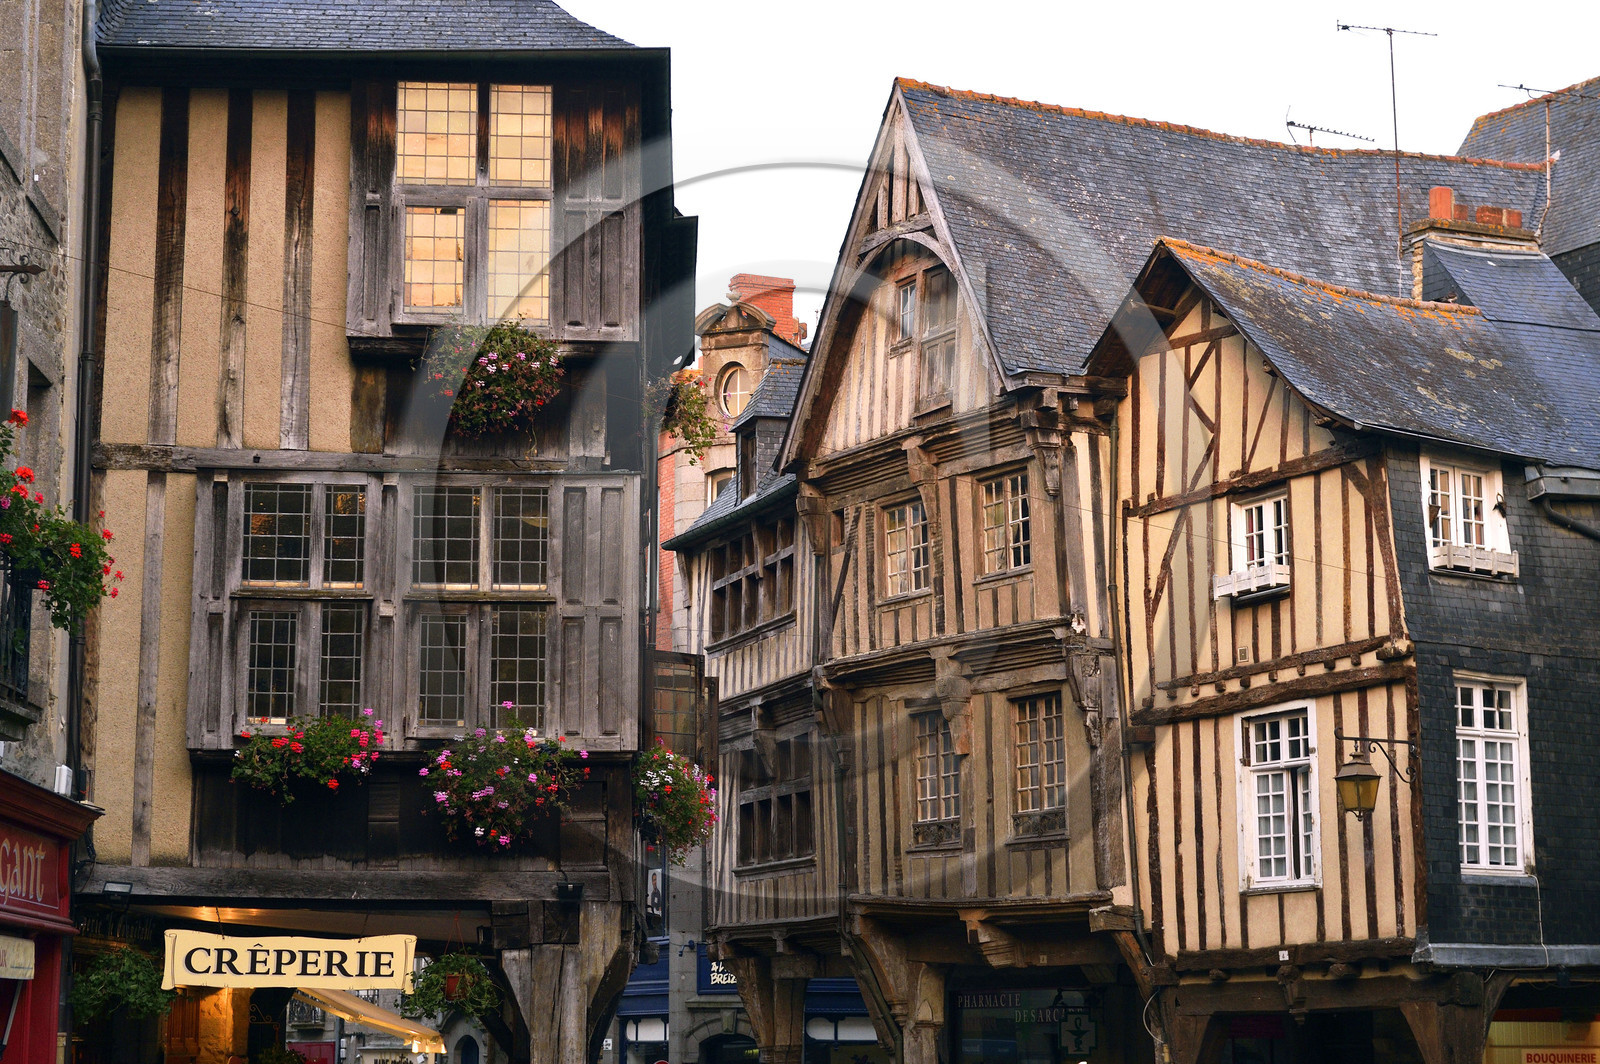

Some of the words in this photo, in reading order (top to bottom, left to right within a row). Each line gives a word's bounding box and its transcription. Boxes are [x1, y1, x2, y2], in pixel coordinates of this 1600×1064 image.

[184, 943, 395, 978] CRÊPERIE
[957, 992, 1021, 1008] PHARMACIE
[1526, 1053, 1597, 1064] BOUQUINERIE
